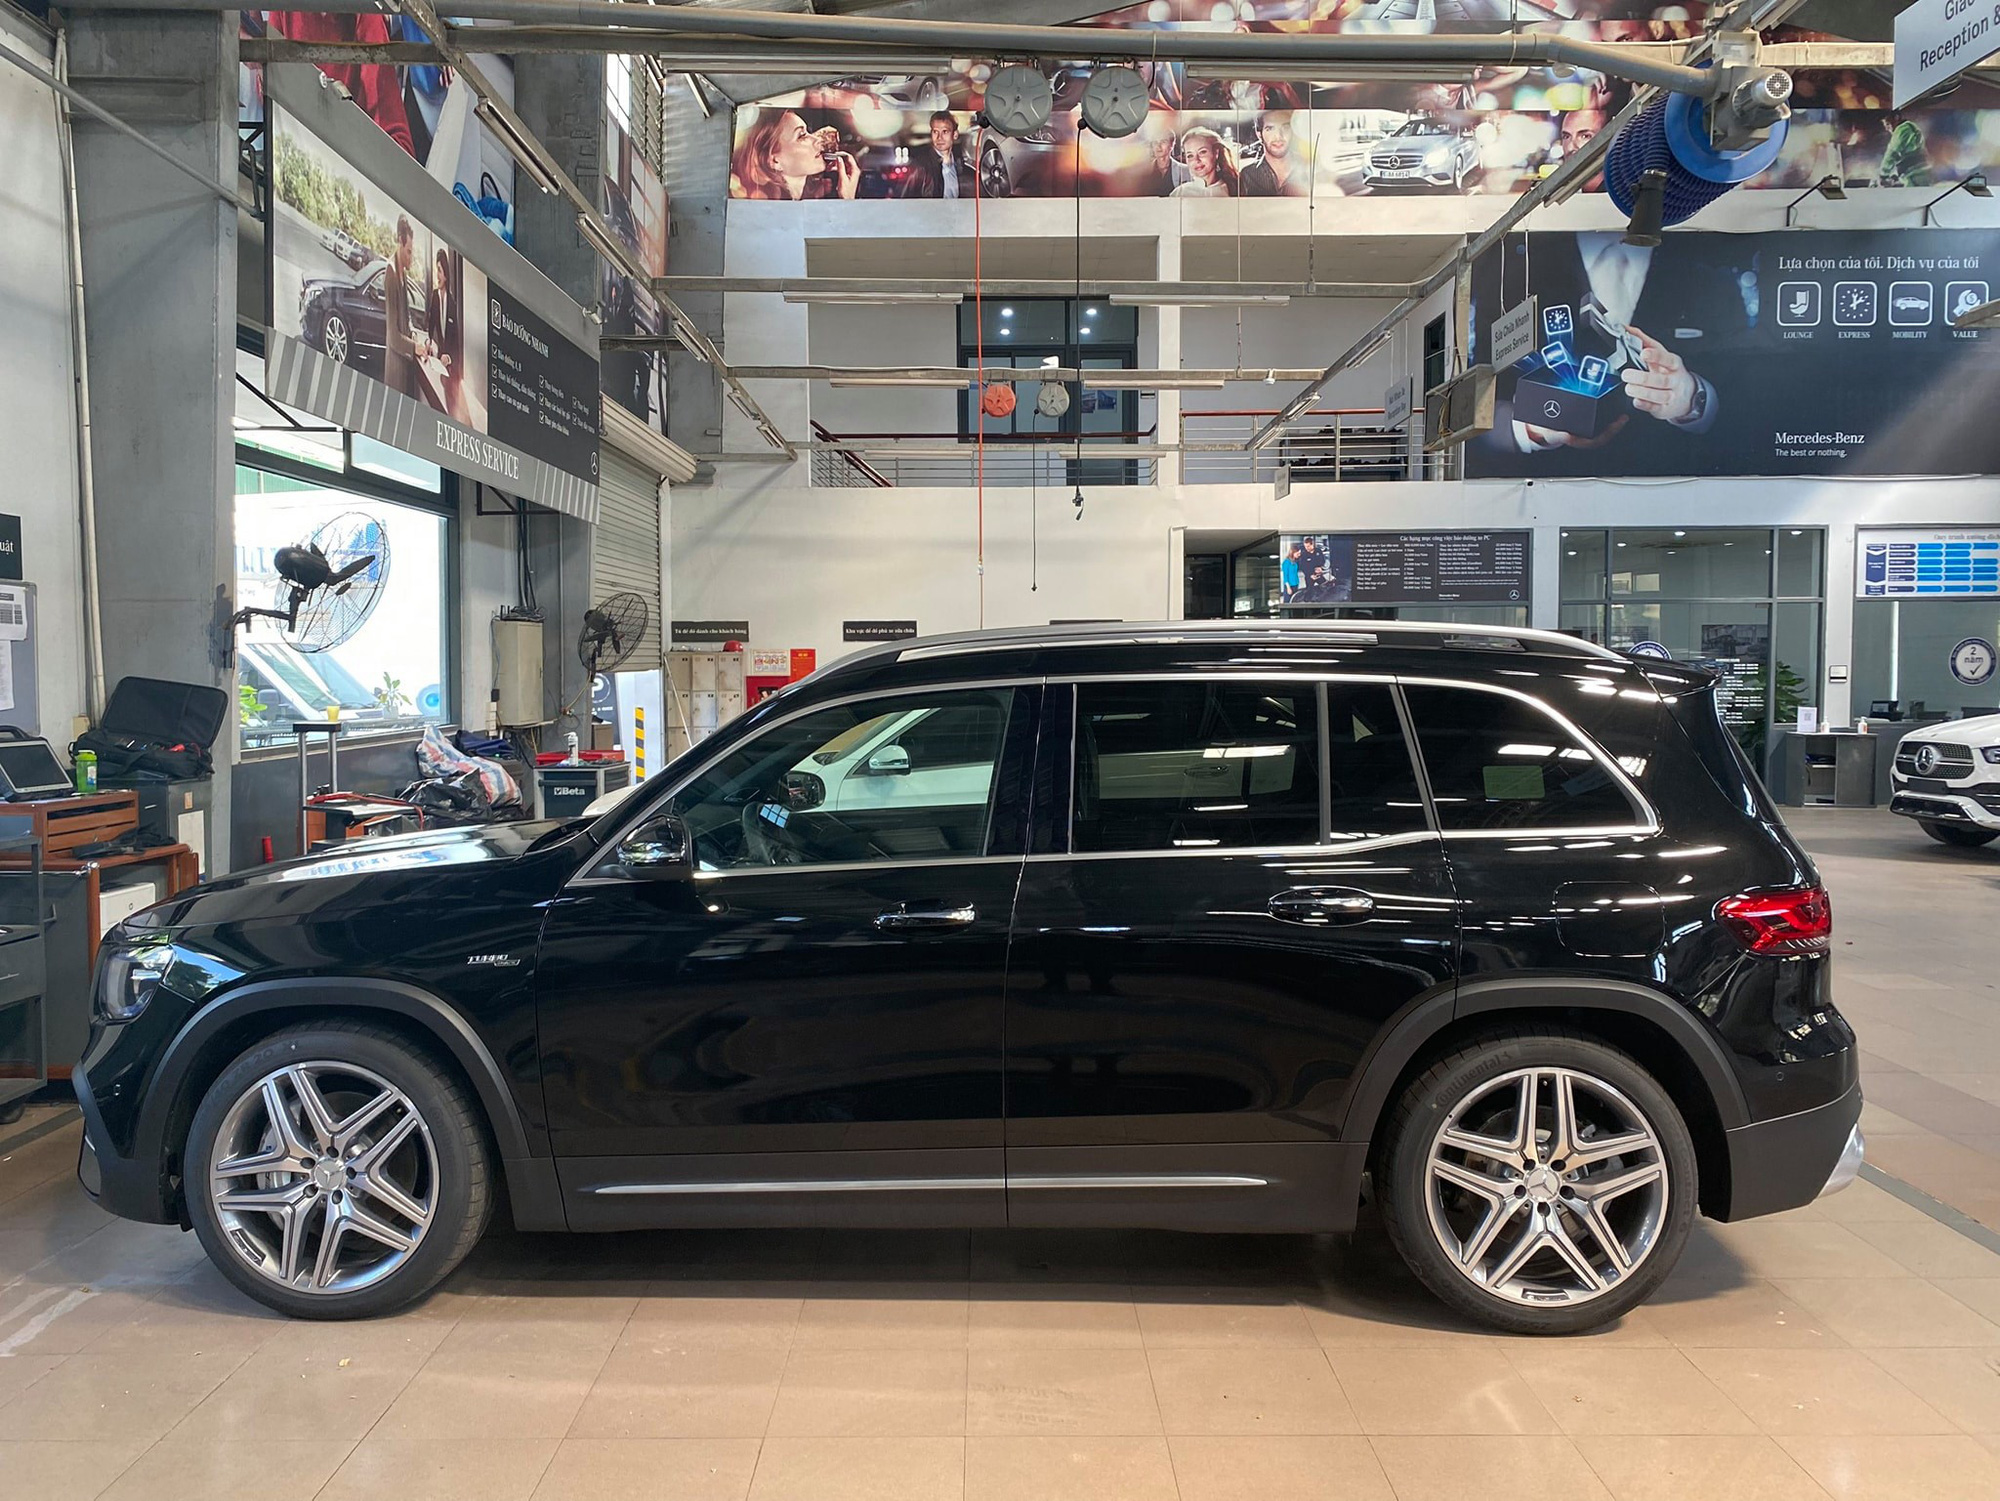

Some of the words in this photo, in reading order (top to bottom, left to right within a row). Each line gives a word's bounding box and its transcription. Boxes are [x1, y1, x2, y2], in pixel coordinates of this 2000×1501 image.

[1920, 17, 1989, 72] Reception
[1779, 256, 1802, 272] Lựa
[1805, 256, 1835, 272] chọn
[1838, 255, 1862, 269] của
[1864, 255, 1884, 269] tôi.
[1887, 255, 1915, 272] Dịch
[1919, 258, 1934, 271] vụ
[1937, 255, 1960, 269] của
[1963, 255, 1980, 269] tôi
[1783, 331, 1814, 339] LOUNGE
[1838, 331, 1871, 339] EXPRESS
[1892, 331, 1928, 339] MOBILITY
[1952, 330, 1979, 339] VALUE
[1512, 332, 1529, 350] Service
[1775, 432, 1865, 444] Mercedes-Benz
[436, 420, 480, 464] EXPRESS
[482, 442, 519, 480] SERVICE
[1775, 448, 1789, 457] The
[1790, 448, 1807, 457] best
[1817, 448, 1848, 458] nothing.
[1970, 646, 1977, 655] 2
[591, 677, 604, 698] P
[563, 787, 585, 796] Beta
[1435, 1054, 1502, 1107] Continental
